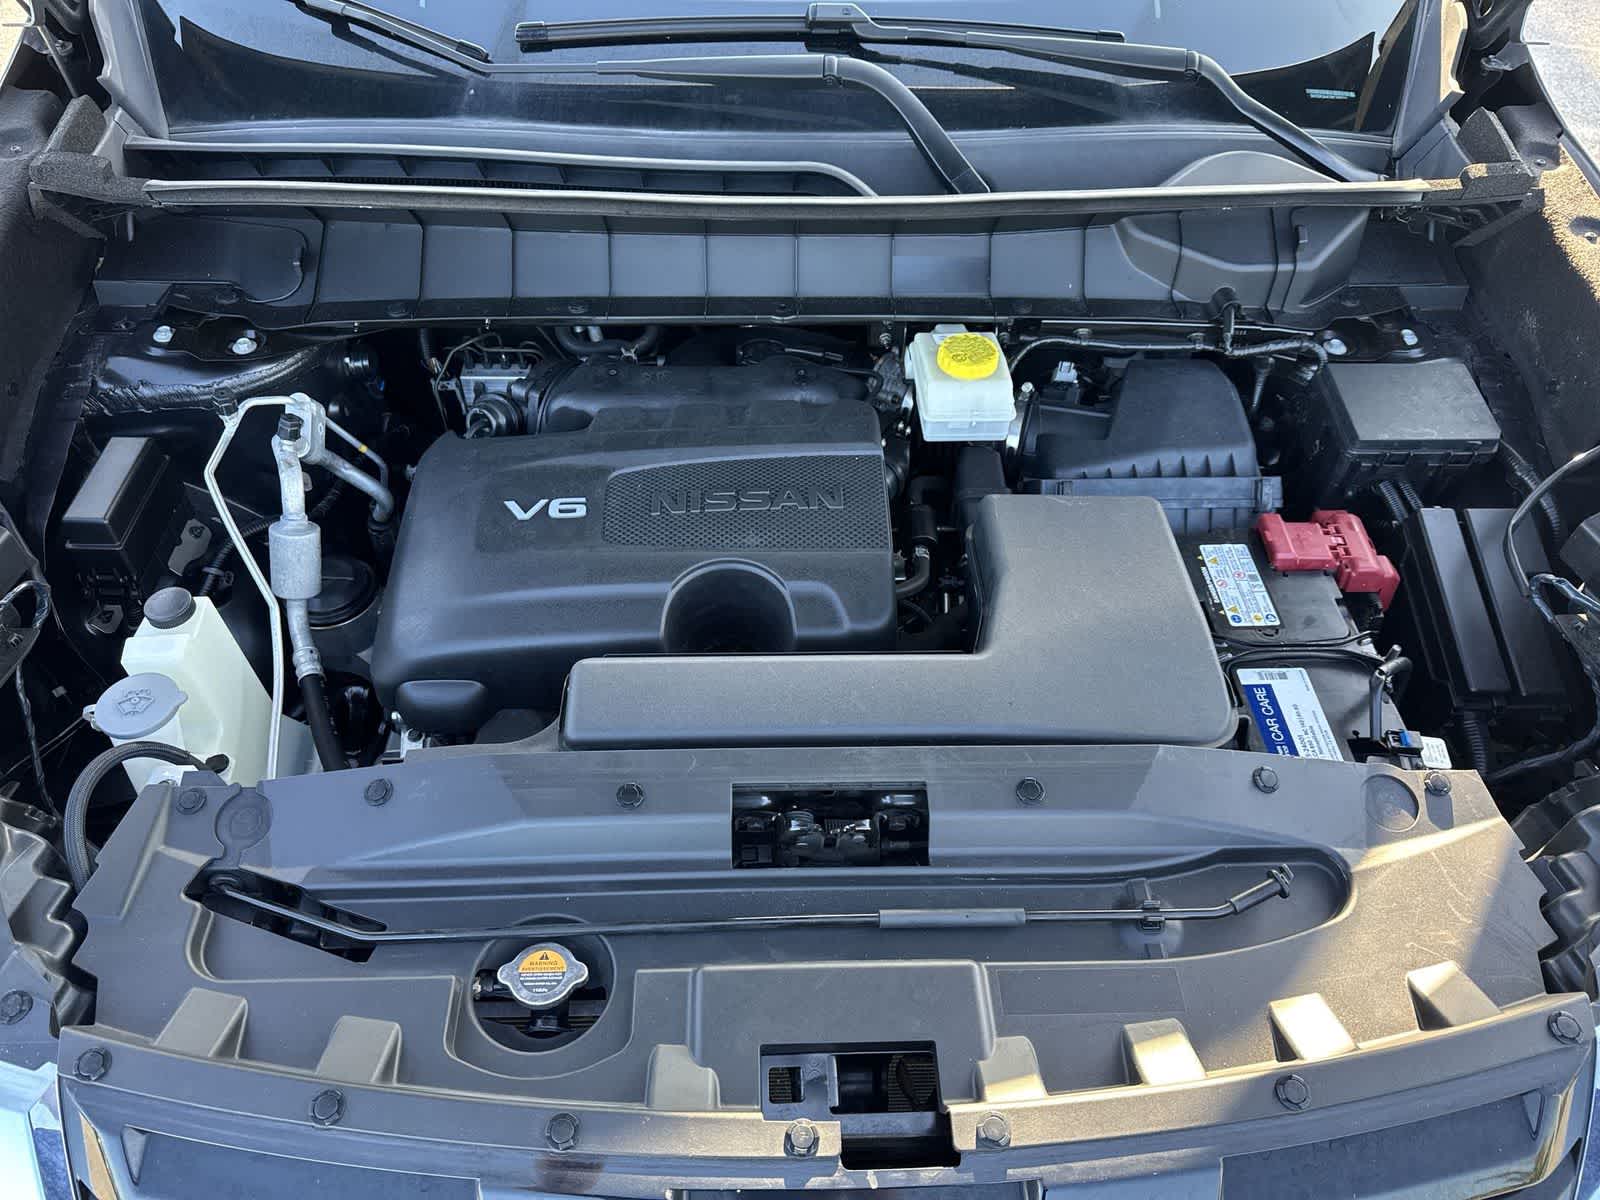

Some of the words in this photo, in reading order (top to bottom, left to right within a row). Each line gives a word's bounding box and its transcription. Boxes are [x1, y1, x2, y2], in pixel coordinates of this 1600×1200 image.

[503, 497, 588, 521] V6
[650, 486, 845, 515] NISSAN
[1253, 687, 1275, 716] CARE
[1266, 718, 1285, 741] CAR
